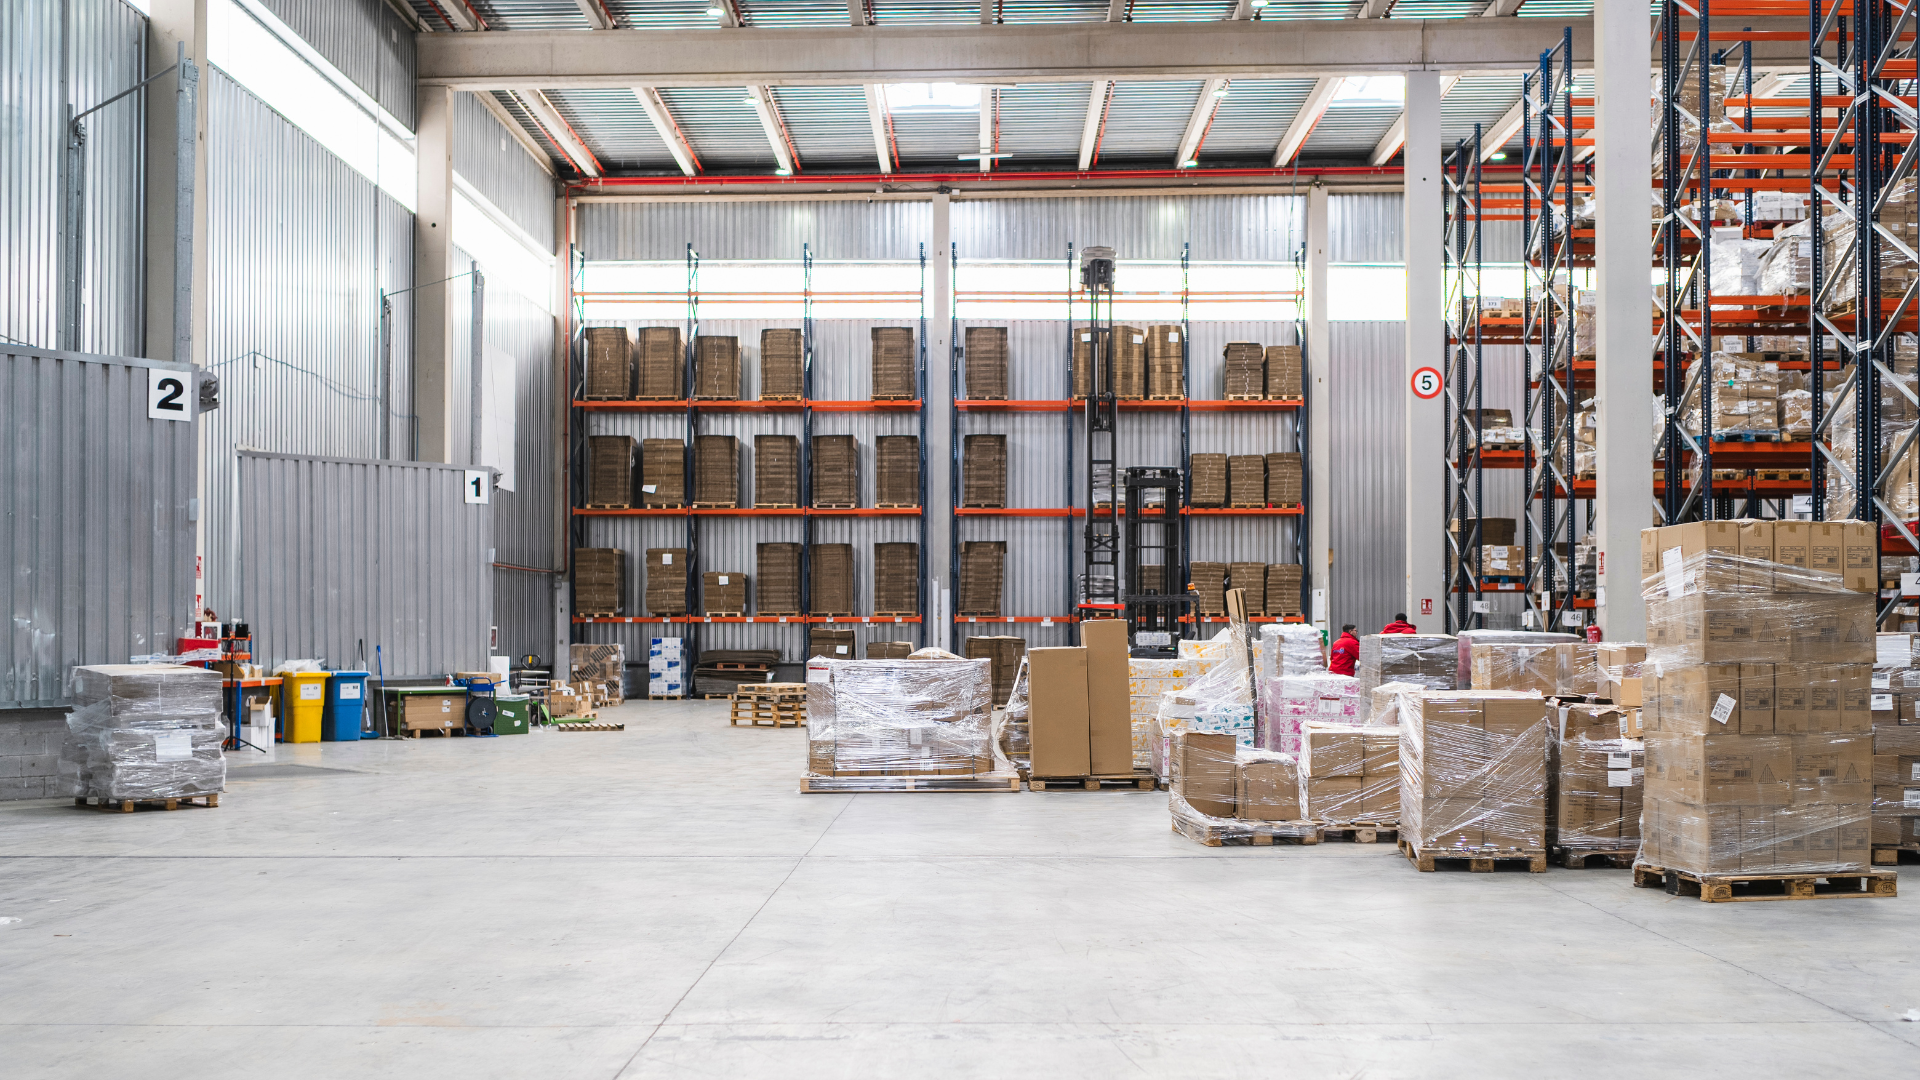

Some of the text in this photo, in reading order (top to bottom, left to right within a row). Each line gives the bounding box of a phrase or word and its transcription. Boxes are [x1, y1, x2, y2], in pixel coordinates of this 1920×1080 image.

[1421, 375, 1432, 391] 5
[156, 378, 184, 411] 2
[470, 477, 481, 497] 1
[1805, 497, 1812, 507] 4
[1570, 613, 1581, 621] 46
